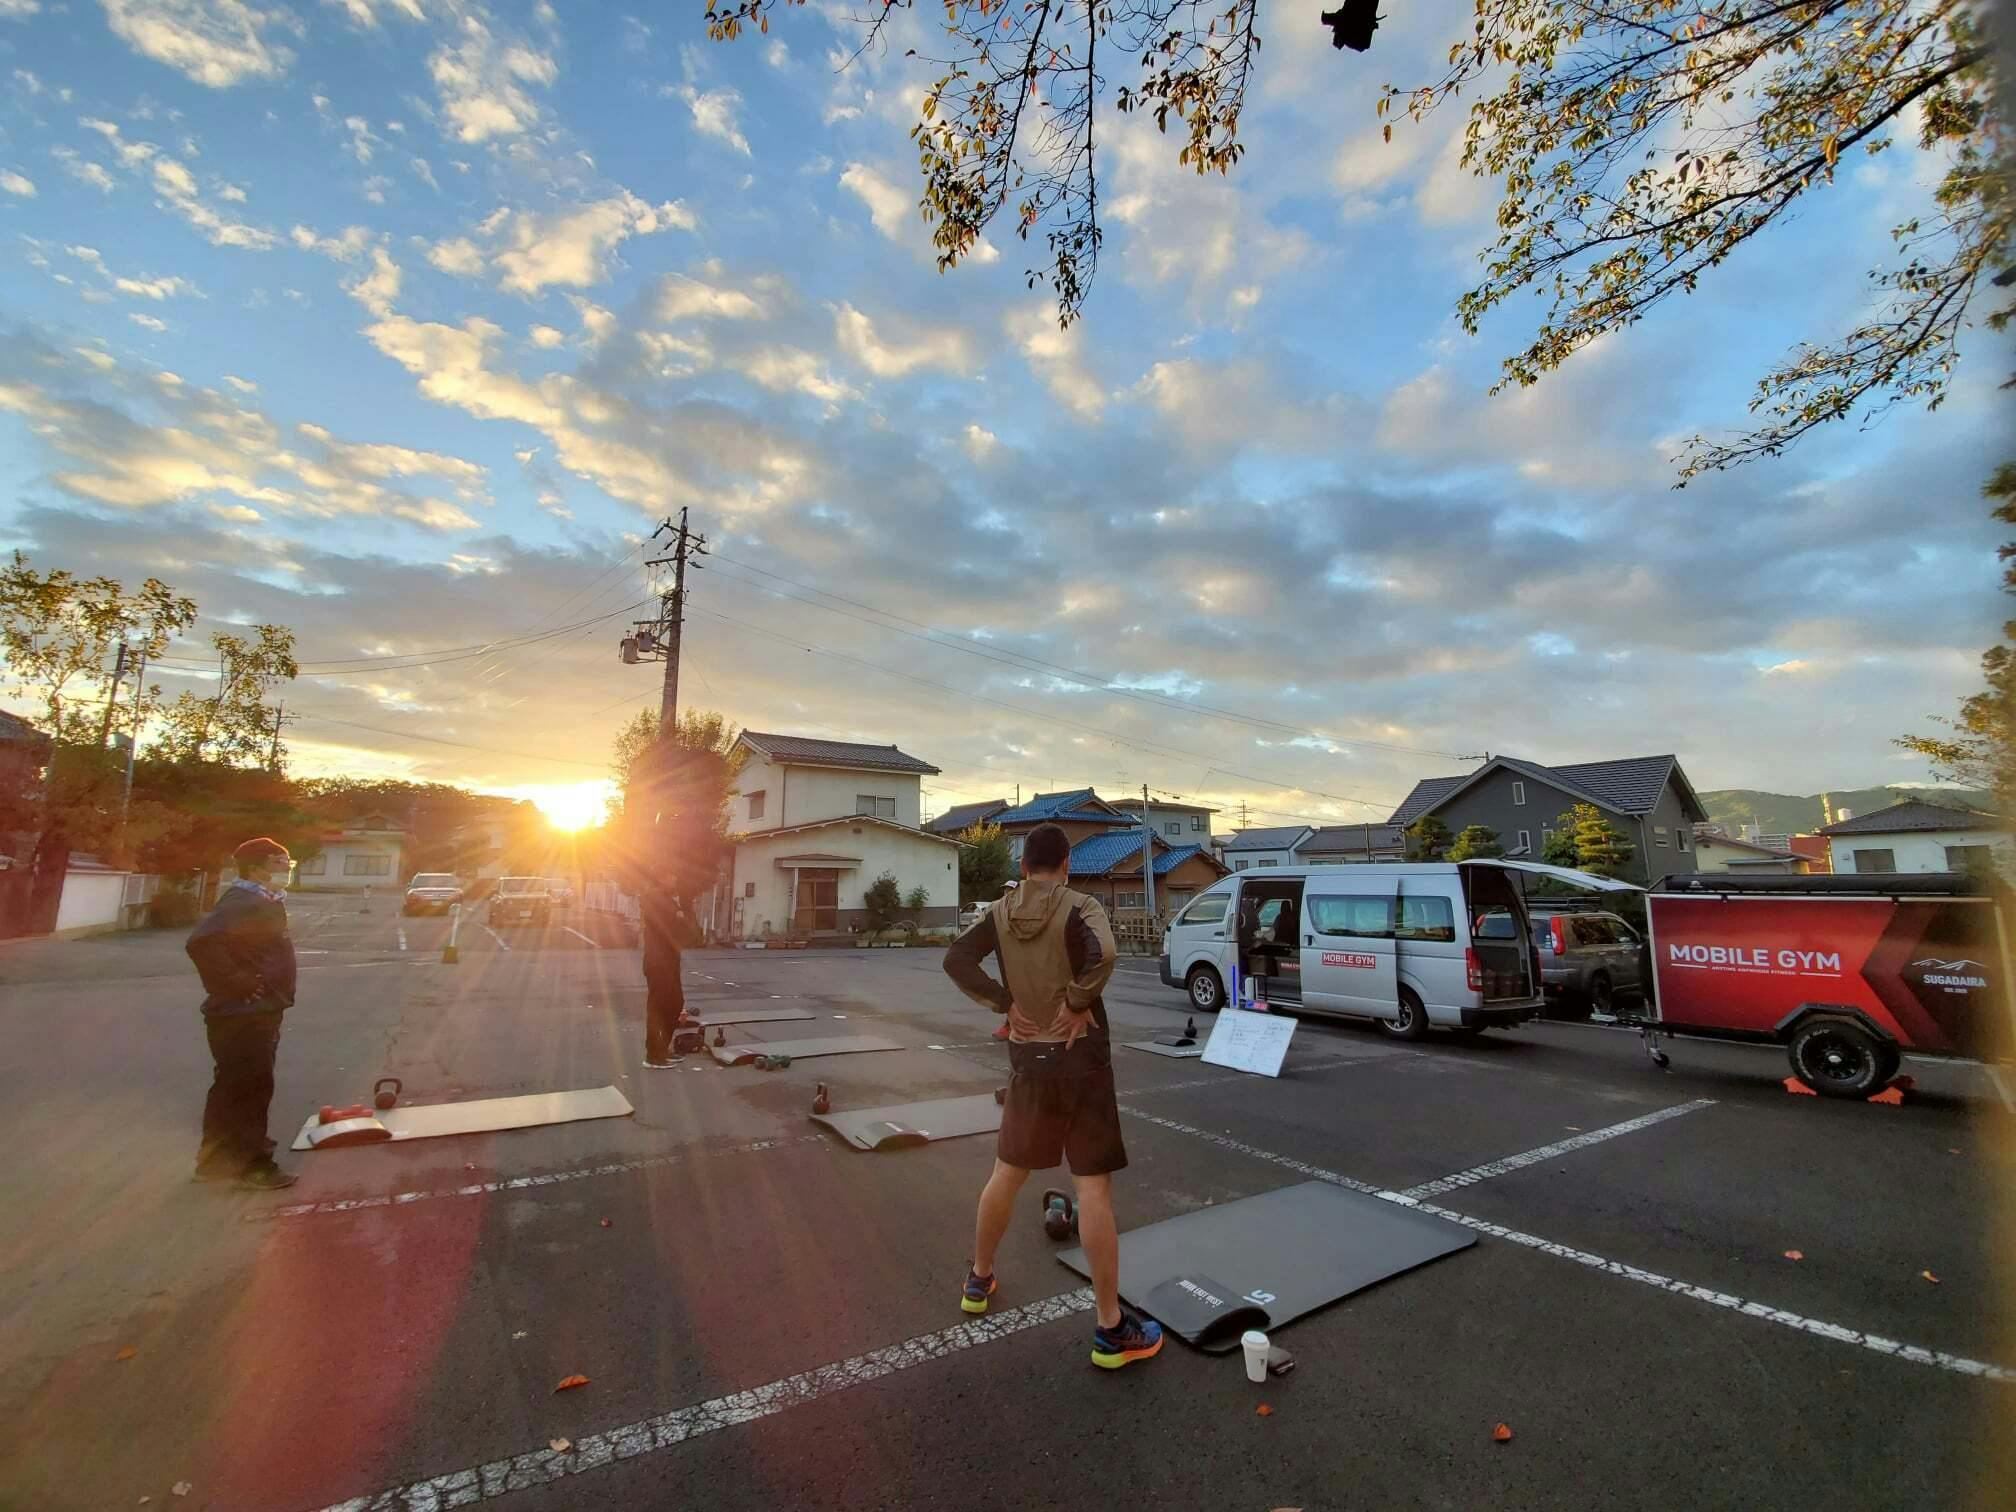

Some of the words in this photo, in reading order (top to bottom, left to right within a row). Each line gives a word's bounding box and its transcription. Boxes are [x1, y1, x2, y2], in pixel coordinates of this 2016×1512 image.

[1323, 953, 1354, 963] MOBILE
[1355, 955, 1375, 966] GYM
[1669, 943, 1770, 966] MOBILE
[1777, 950, 1841, 971] GYM
[1923, 974, 1987, 987] SUGADAIRA
